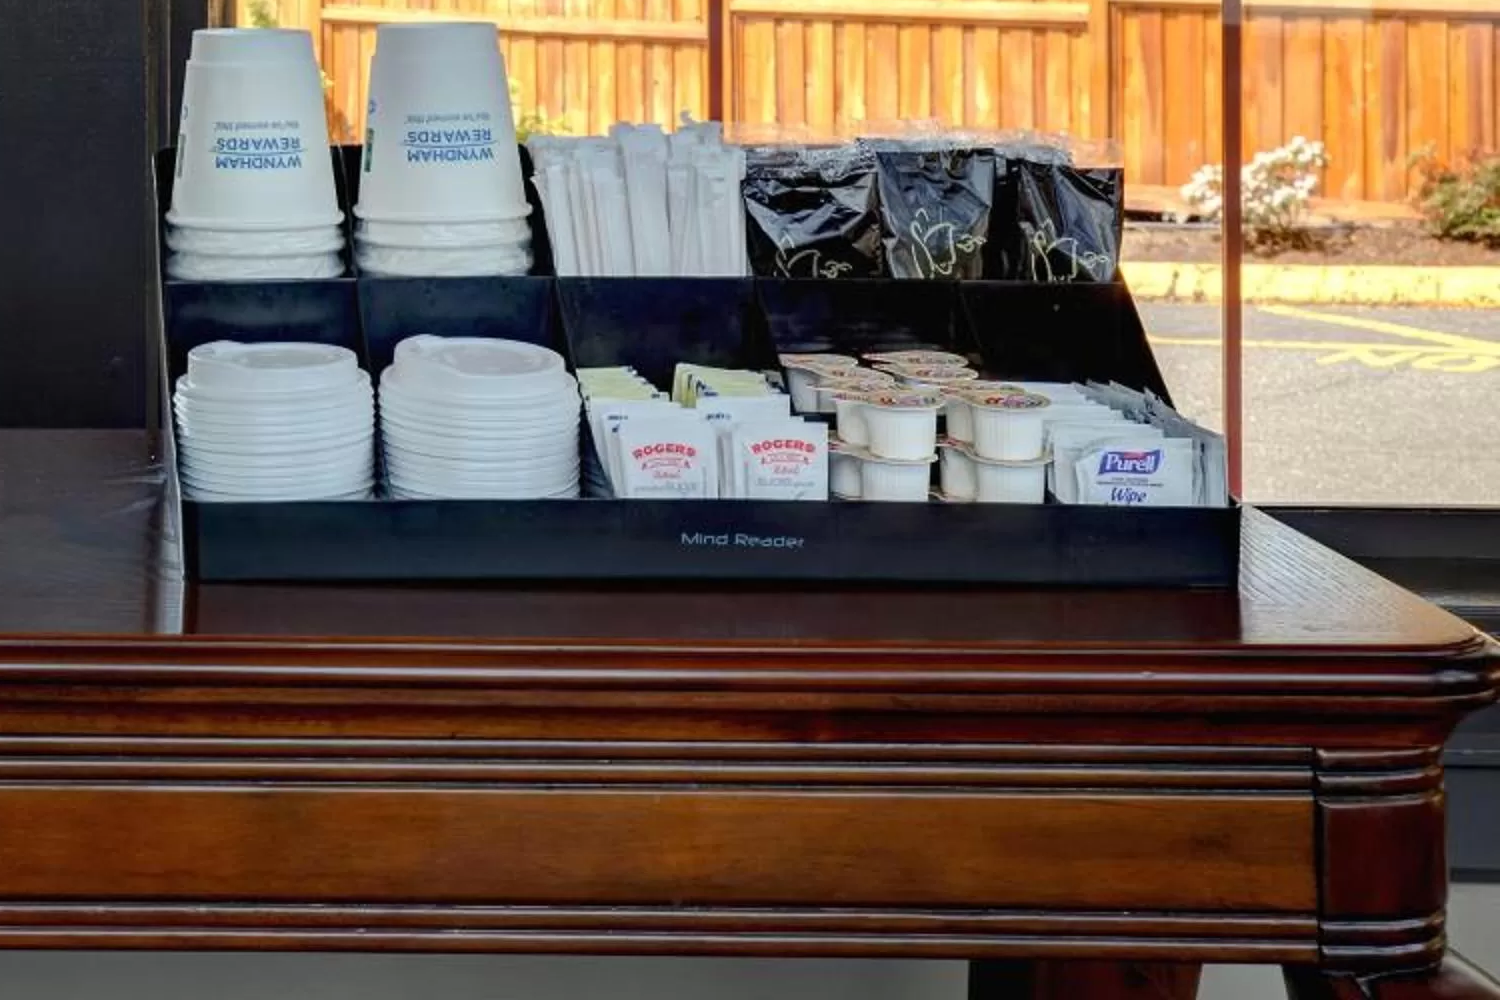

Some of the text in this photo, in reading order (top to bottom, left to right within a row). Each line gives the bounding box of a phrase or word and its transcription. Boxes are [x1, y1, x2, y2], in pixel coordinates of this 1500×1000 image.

[407, 128, 491, 143] REWARDS
[216, 137, 301, 151] REWARDS
[215, 155, 302, 169] WYNDHAM
[407, 148, 494, 162] WYNDHAM
[632, 443, 697, 460] ROGERS
[750, 439, 817, 455] ROGERS
[1104, 453, 1155, 472] Purell
[681, 532, 805, 549] Mind Reader
